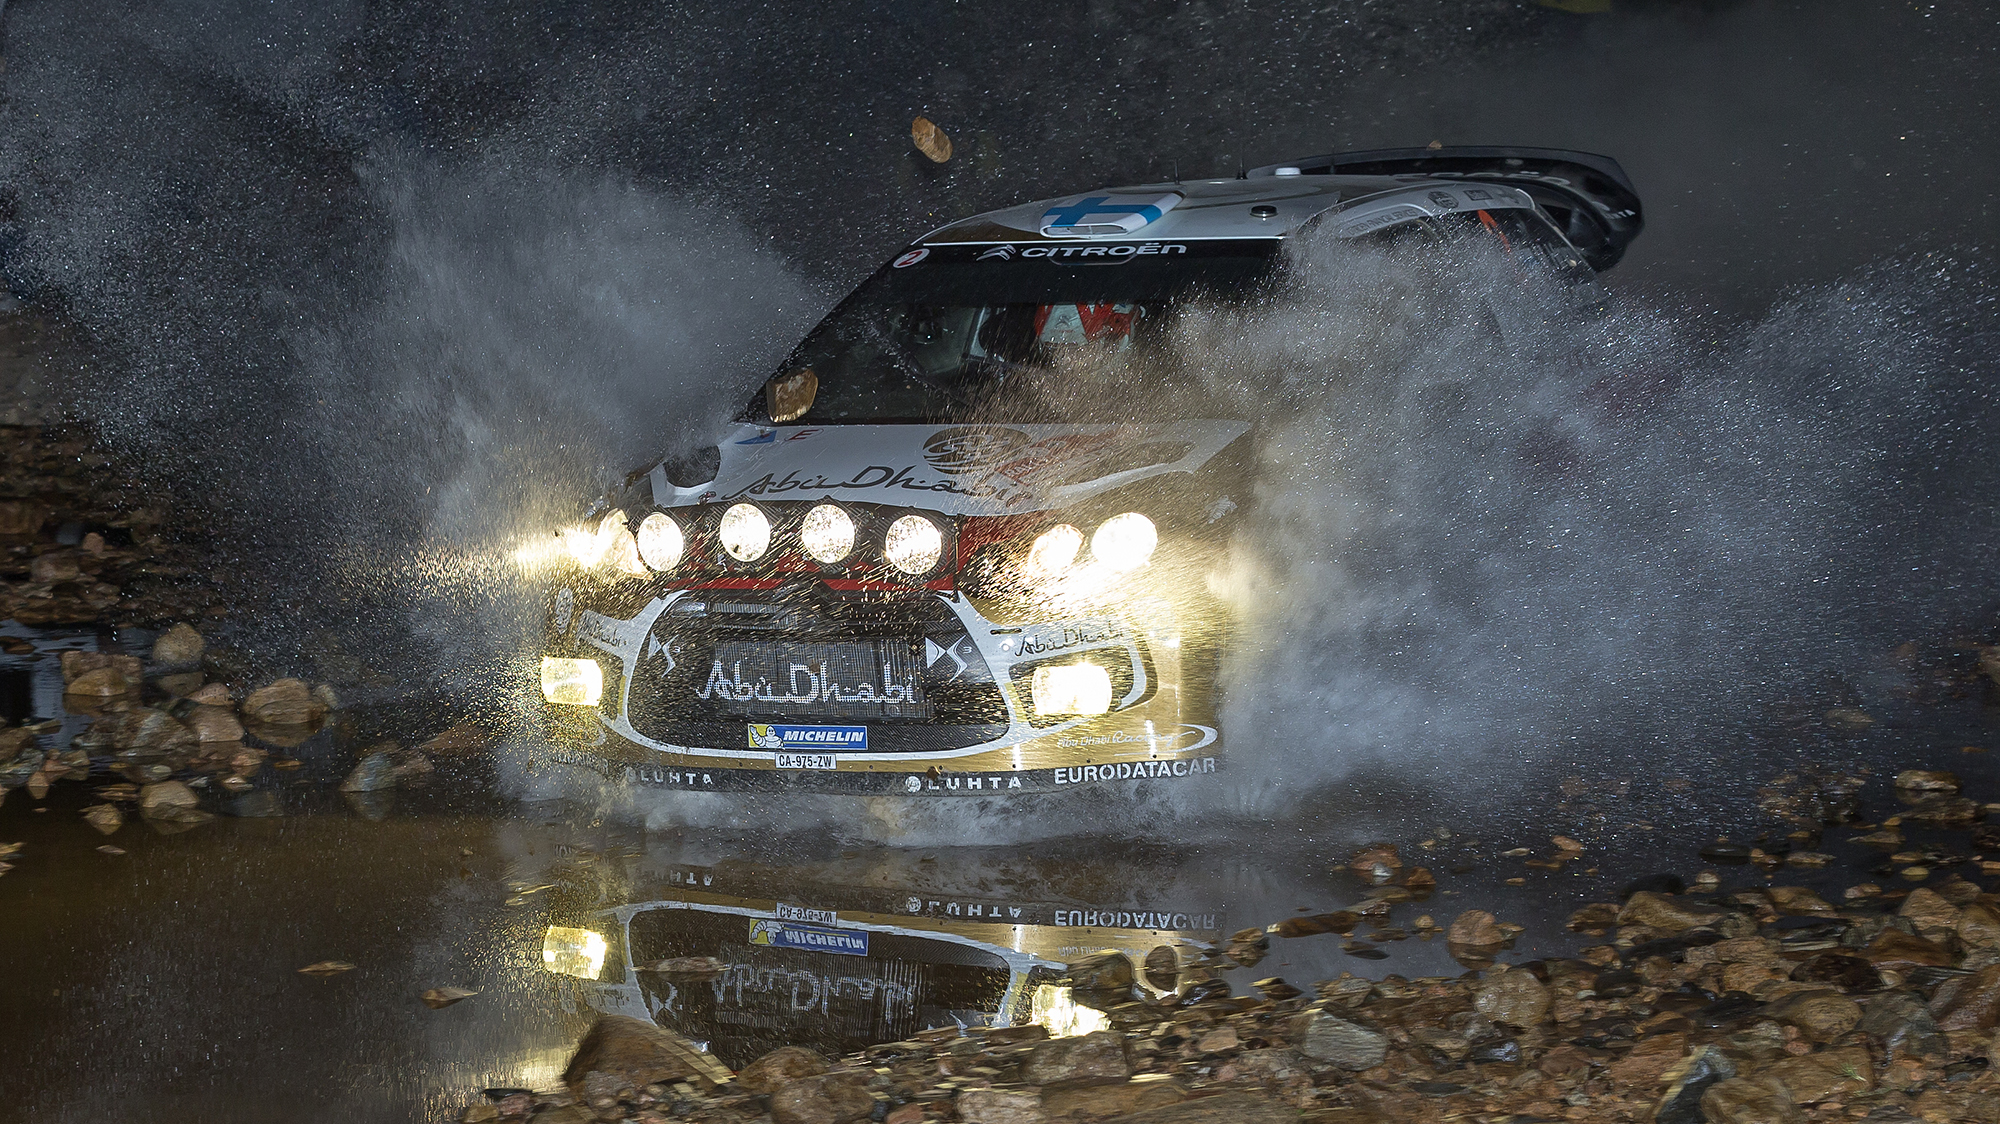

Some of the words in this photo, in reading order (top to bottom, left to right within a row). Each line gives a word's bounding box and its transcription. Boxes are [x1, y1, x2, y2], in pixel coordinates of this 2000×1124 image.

[1022, 242, 1187, 257] CITROËN
[696, 660, 784, 701] Abu
[786, 660, 917, 703] Dhabi
[782, 729, 864, 743] MICHELIN
[778, 753, 833, 768] CA-975-ZW
[1054, 757, 1216, 786] EURODATACAR
[928, 776, 1022, 791] LUHTA
